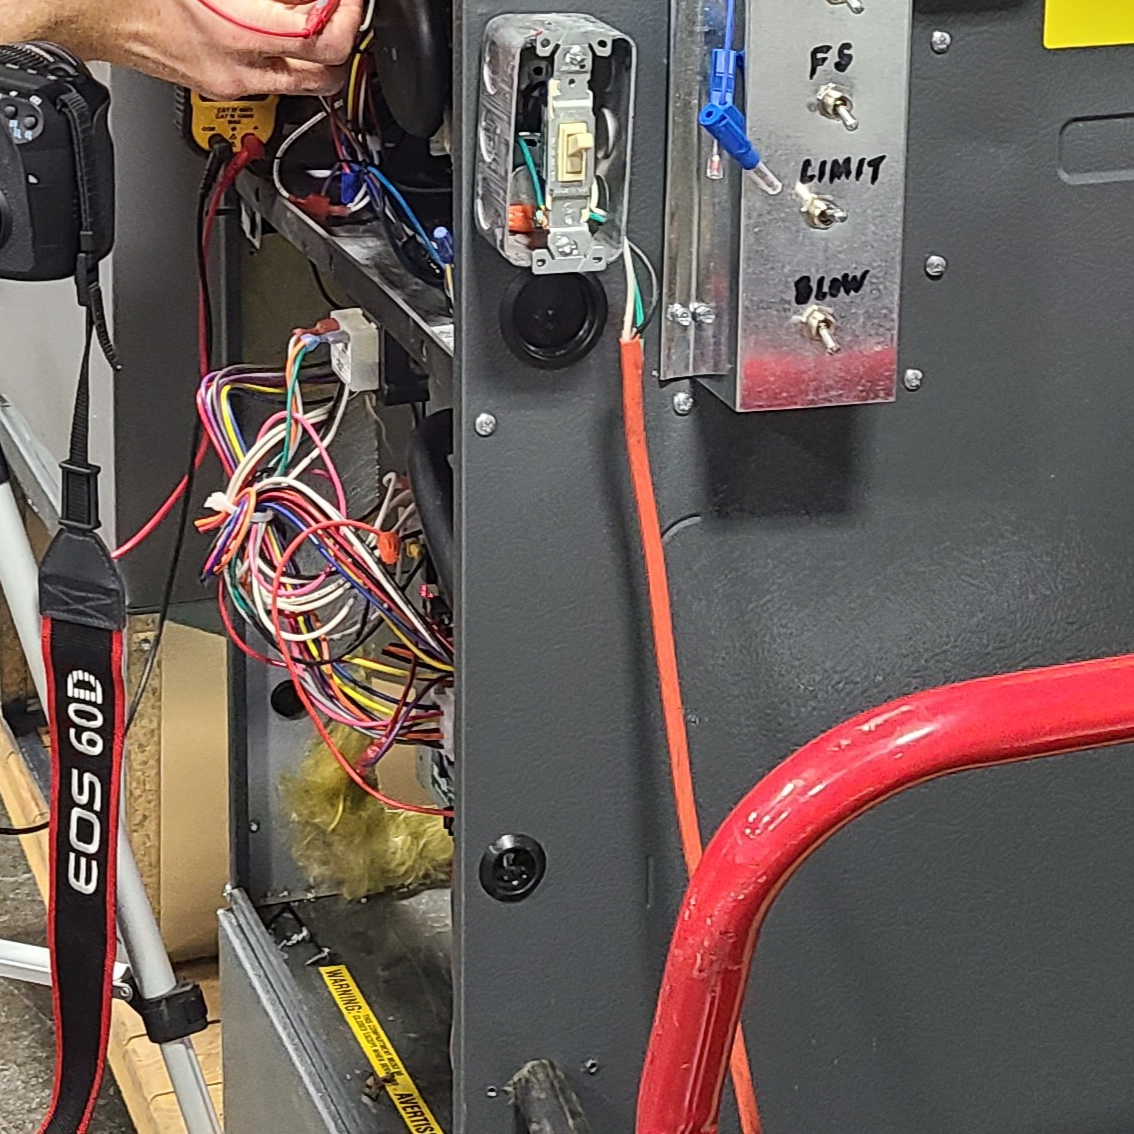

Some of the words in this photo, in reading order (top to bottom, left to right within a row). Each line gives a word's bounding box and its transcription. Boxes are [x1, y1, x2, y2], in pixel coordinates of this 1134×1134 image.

[809, 42, 853, 80] FS
[800, 155, 887, 185] LIMIT
[794, 269, 871, 305] BLOW
[66, 669, 104, 756] 60D
[68, 768, 102, 895] EOS
[325, 968, 363, 1015] WARNING:
[394, 1093, 436, 1134] AVERTIS
